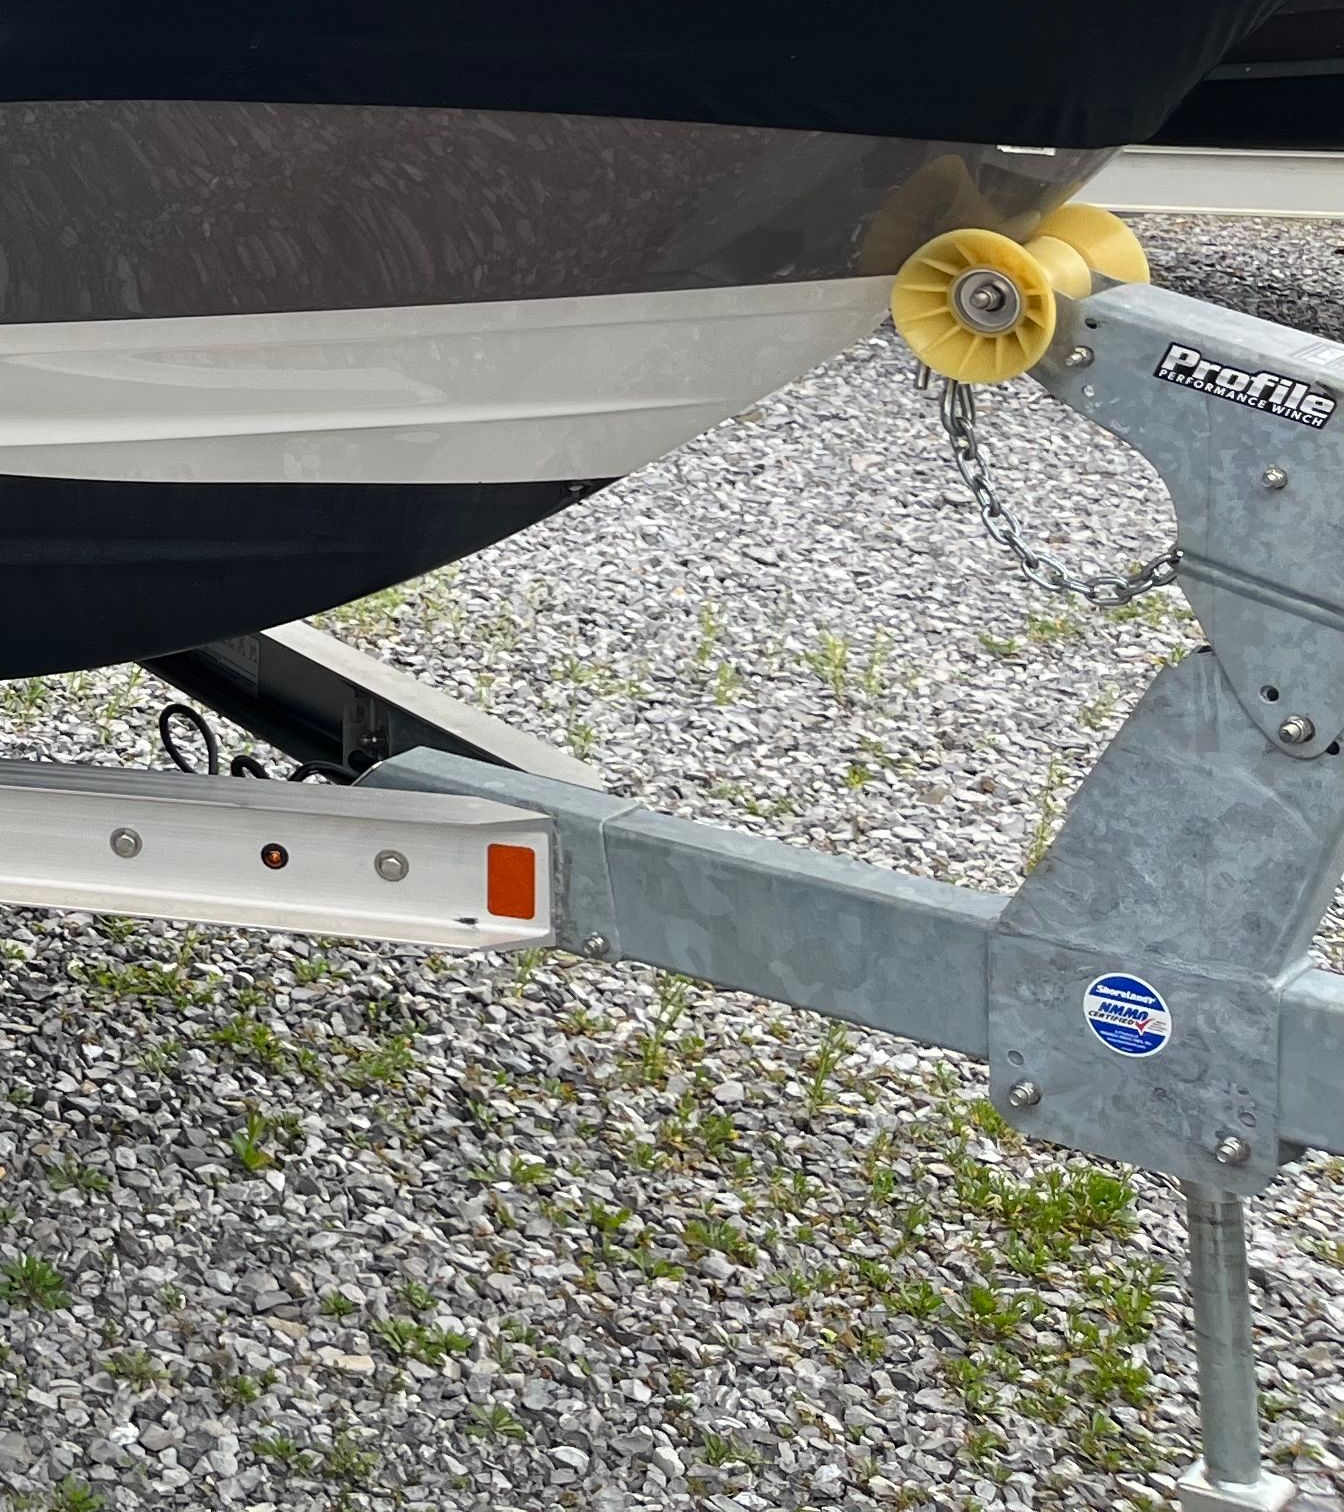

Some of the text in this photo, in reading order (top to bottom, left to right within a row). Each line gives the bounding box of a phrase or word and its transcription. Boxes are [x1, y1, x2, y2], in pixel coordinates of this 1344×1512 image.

[1158, 368, 1323, 427] PERFORMANCE WINCH
[1161, 344, 1336, 419] Profile
[1088, 1010, 1135, 1026] CERTIFIED
